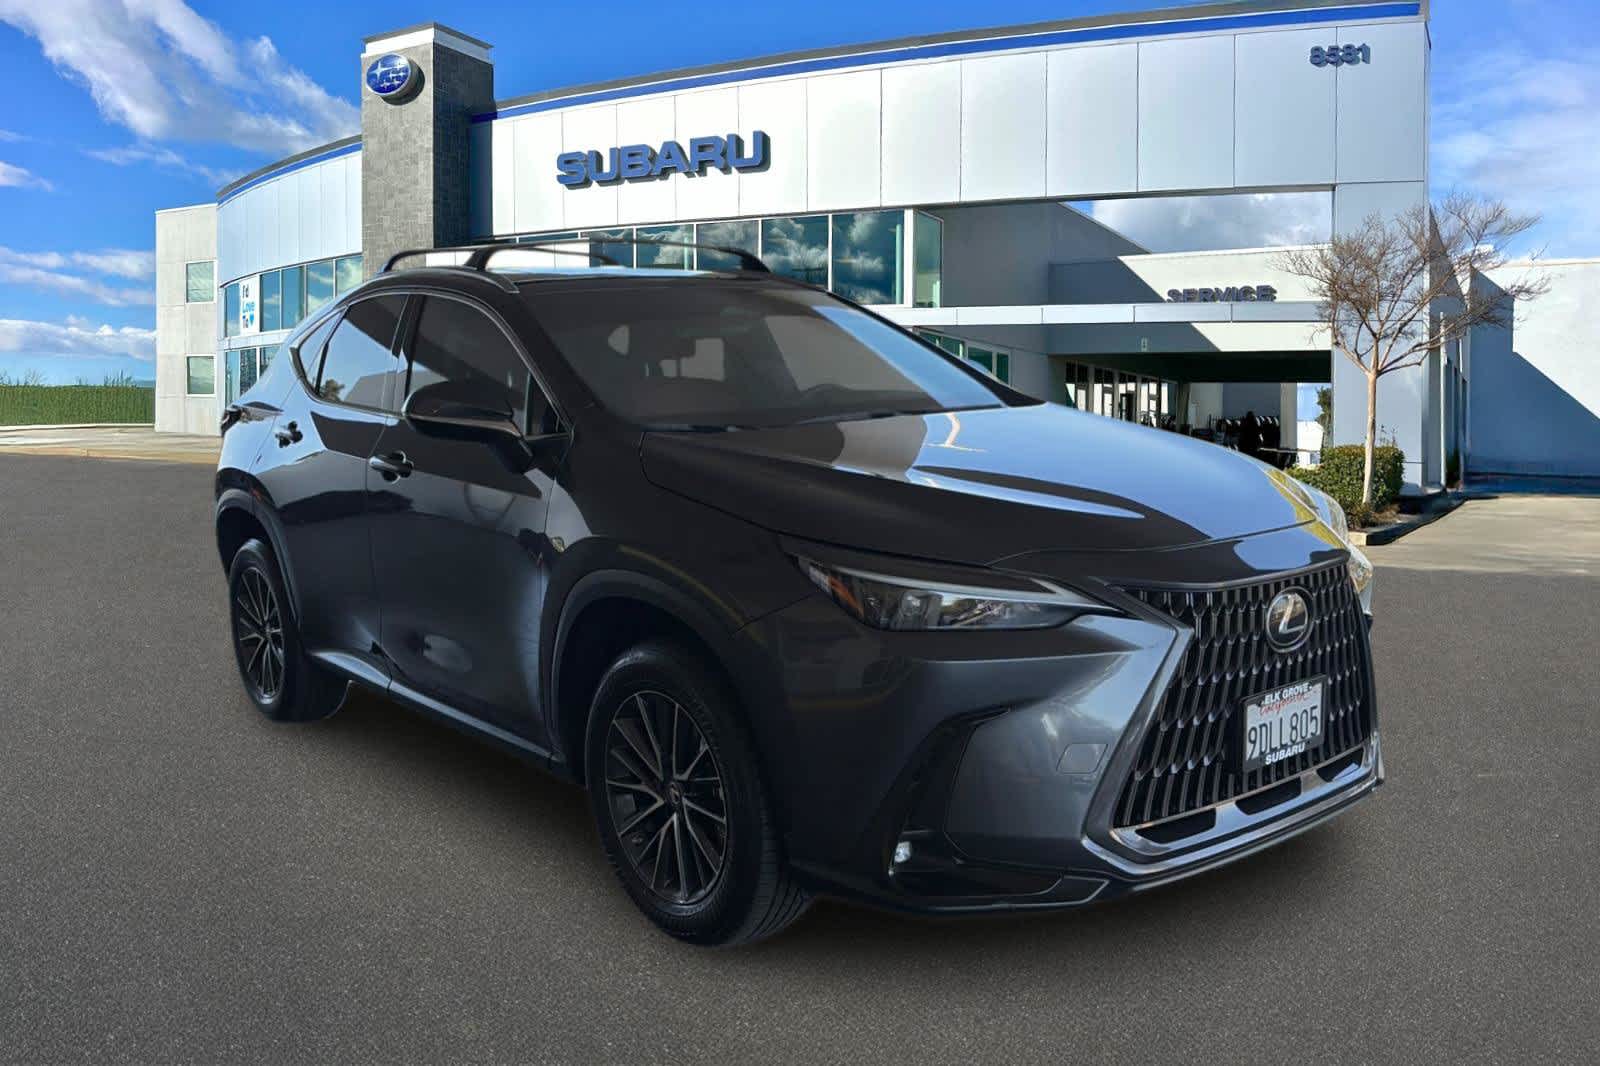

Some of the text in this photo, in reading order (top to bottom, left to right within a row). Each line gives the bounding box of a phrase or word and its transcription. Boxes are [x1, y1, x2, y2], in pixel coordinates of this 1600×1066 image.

[556, 130, 770, 189] SUBARU
[1167, 285, 1277, 303] SERVICE
[1264, 682, 1310, 705] ELK GROVE
[1247, 705, 1319, 761] 9DLL805
[1265, 742, 1306, 765] SUBARU
